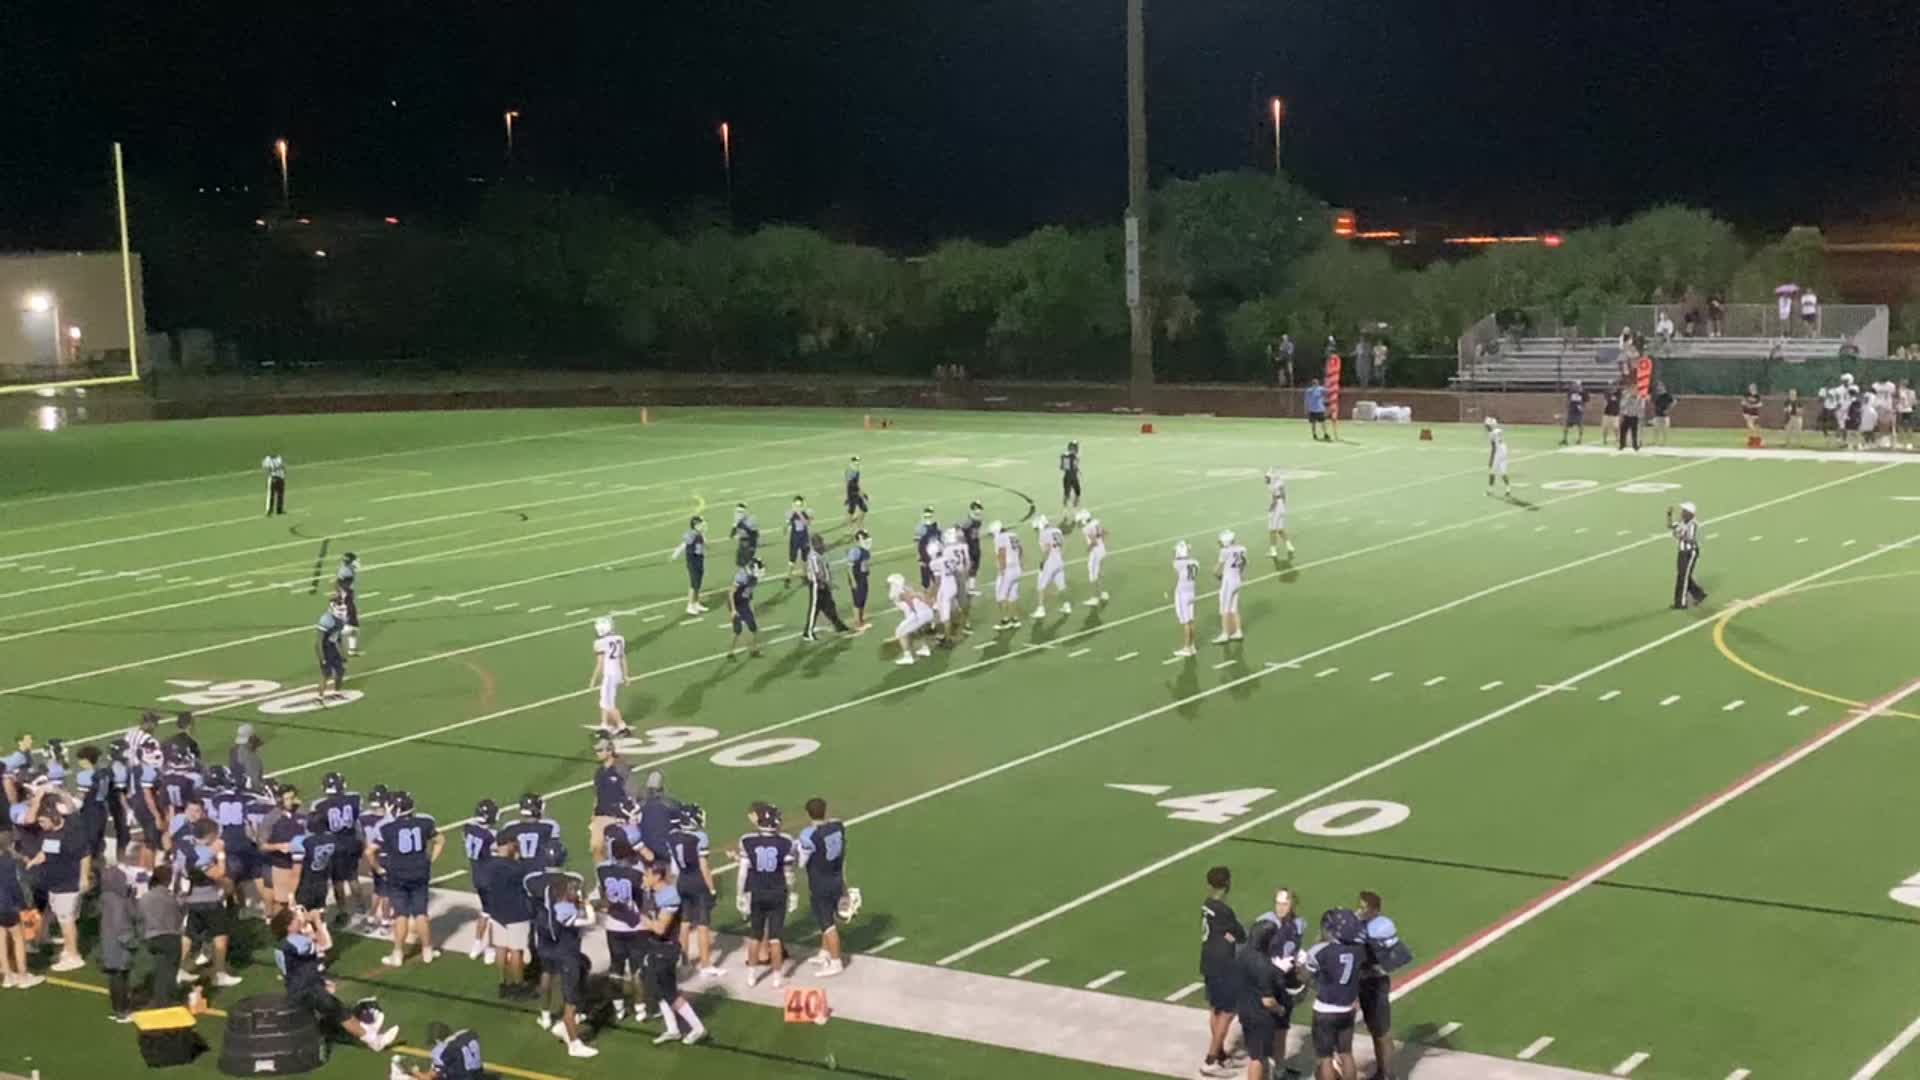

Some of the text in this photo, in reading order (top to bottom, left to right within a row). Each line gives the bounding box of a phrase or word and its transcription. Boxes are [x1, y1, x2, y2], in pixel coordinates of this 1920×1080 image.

[612, 726, 821, 767] 30
[1155, 786, 1411, 837] 40
[1338, 952, 1354, 985] 7
[787, 989, 821, 1020] 40
